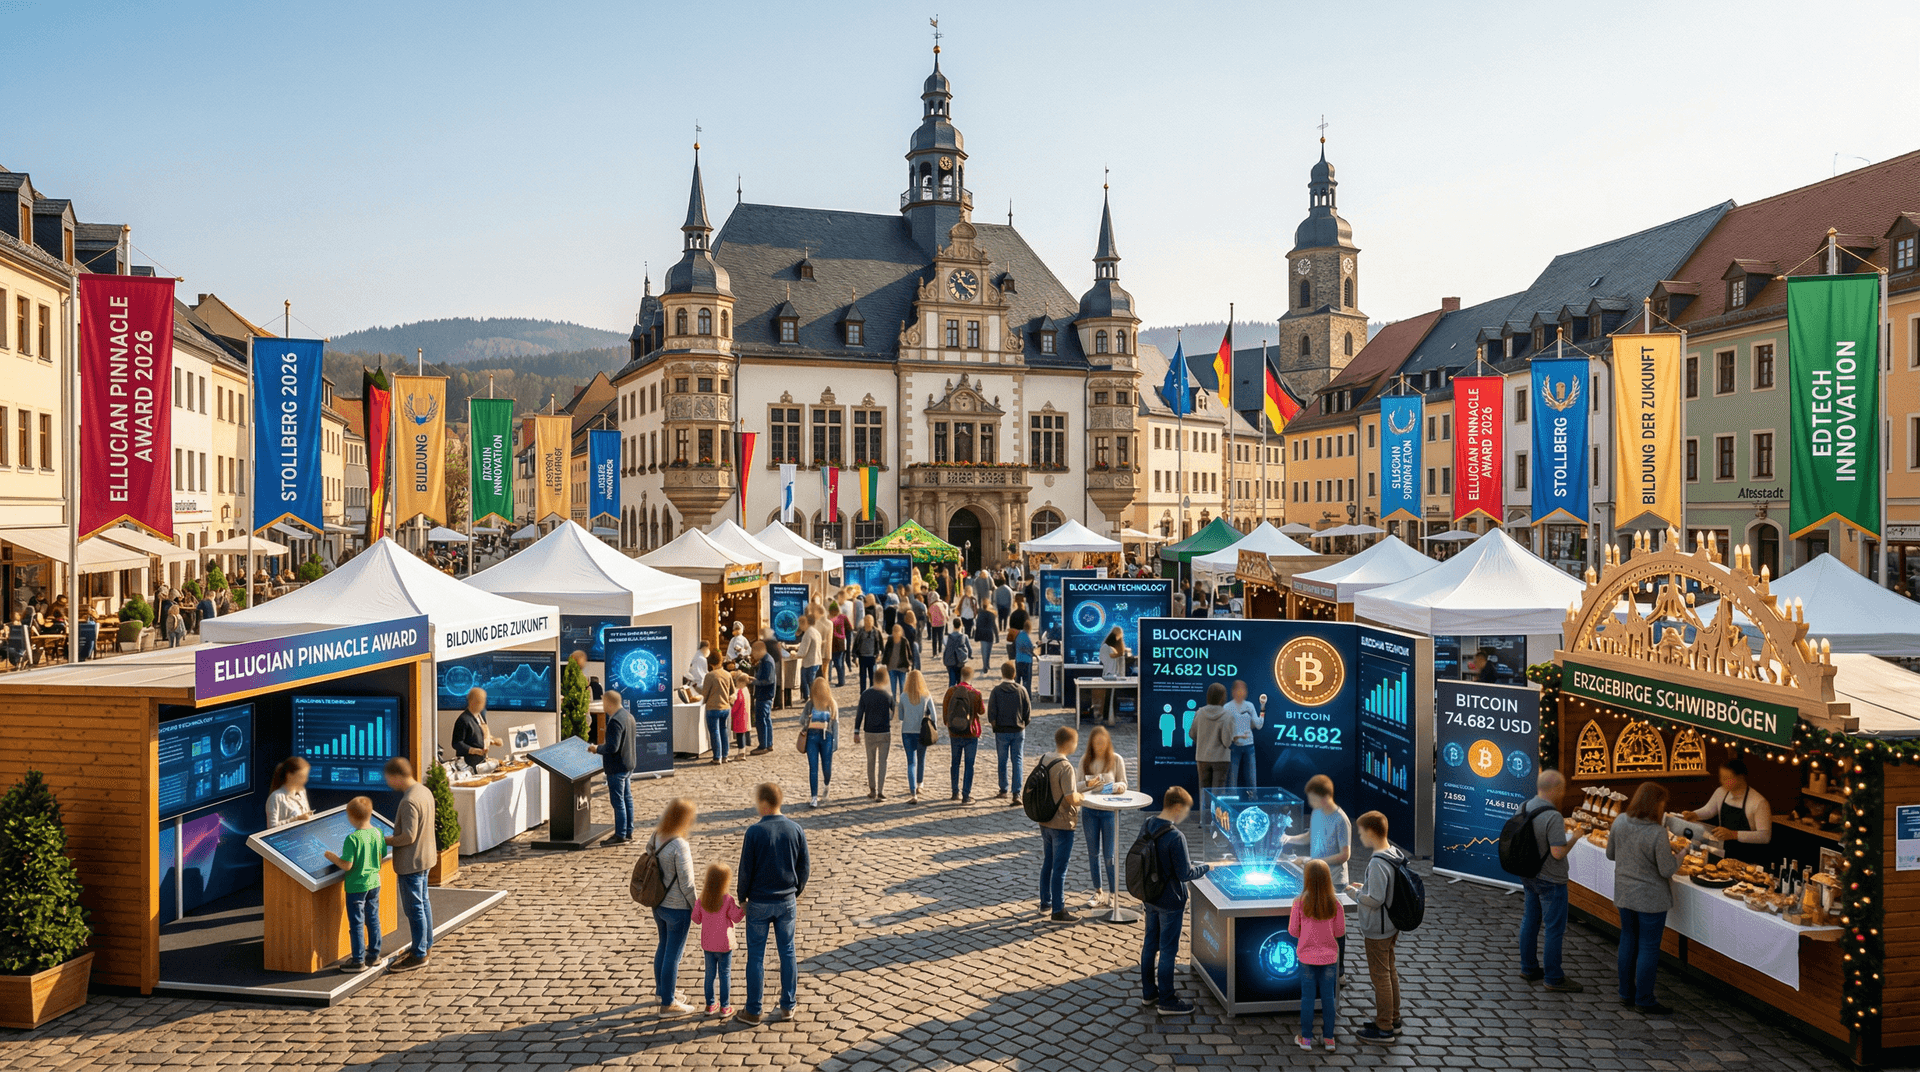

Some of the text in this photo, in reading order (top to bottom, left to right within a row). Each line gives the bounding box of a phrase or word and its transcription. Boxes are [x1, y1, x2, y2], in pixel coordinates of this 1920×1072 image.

[110, 296, 128, 502] ELLUCIAN PINNACLE
[134, 330, 153, 463] AWARD 2026
[1640, 346, 1656, 505] BILDUNG DER ZUKUNFT
[1811, 370, 1832, 456] EDTECH
[1836, 341, 1856, 481] INNOVATION
[281, 352, 297, 501] STOLLBERG 2026
[1467, 388, 1480, 501] ELLUCIAN PINNACLE
[1481, 406, 1493, 478] AWARD 2026
[1554, 417, 1567, 497] STOLLBERG
[1069, 583, 1166, 592] BLOCKCHAIN TECHNOLOGY
[214, 628, 417, 682] ELLUCIAN PINNACLE AWARD
[446, 616, 549, 648] BILDUNG DER ZUKUNFT
[1152, 629, 1242, 642] BLOCKCHAIN
[1152, 647, 1209, 659] BITCOIN
[1153, 663, 1238, 677] 74.682 USD
[1285, 711, 1331, 721] BITCOIN
[1444, 711, 1532, 734] 74.682 USD
[1456, 693, 1518, 713] BITCOIN
[1573, 671, 1777, 734] ERZGEBIRGE SCHWIBBÖGEN
[1273, 724, 1342, 744] 74.682
